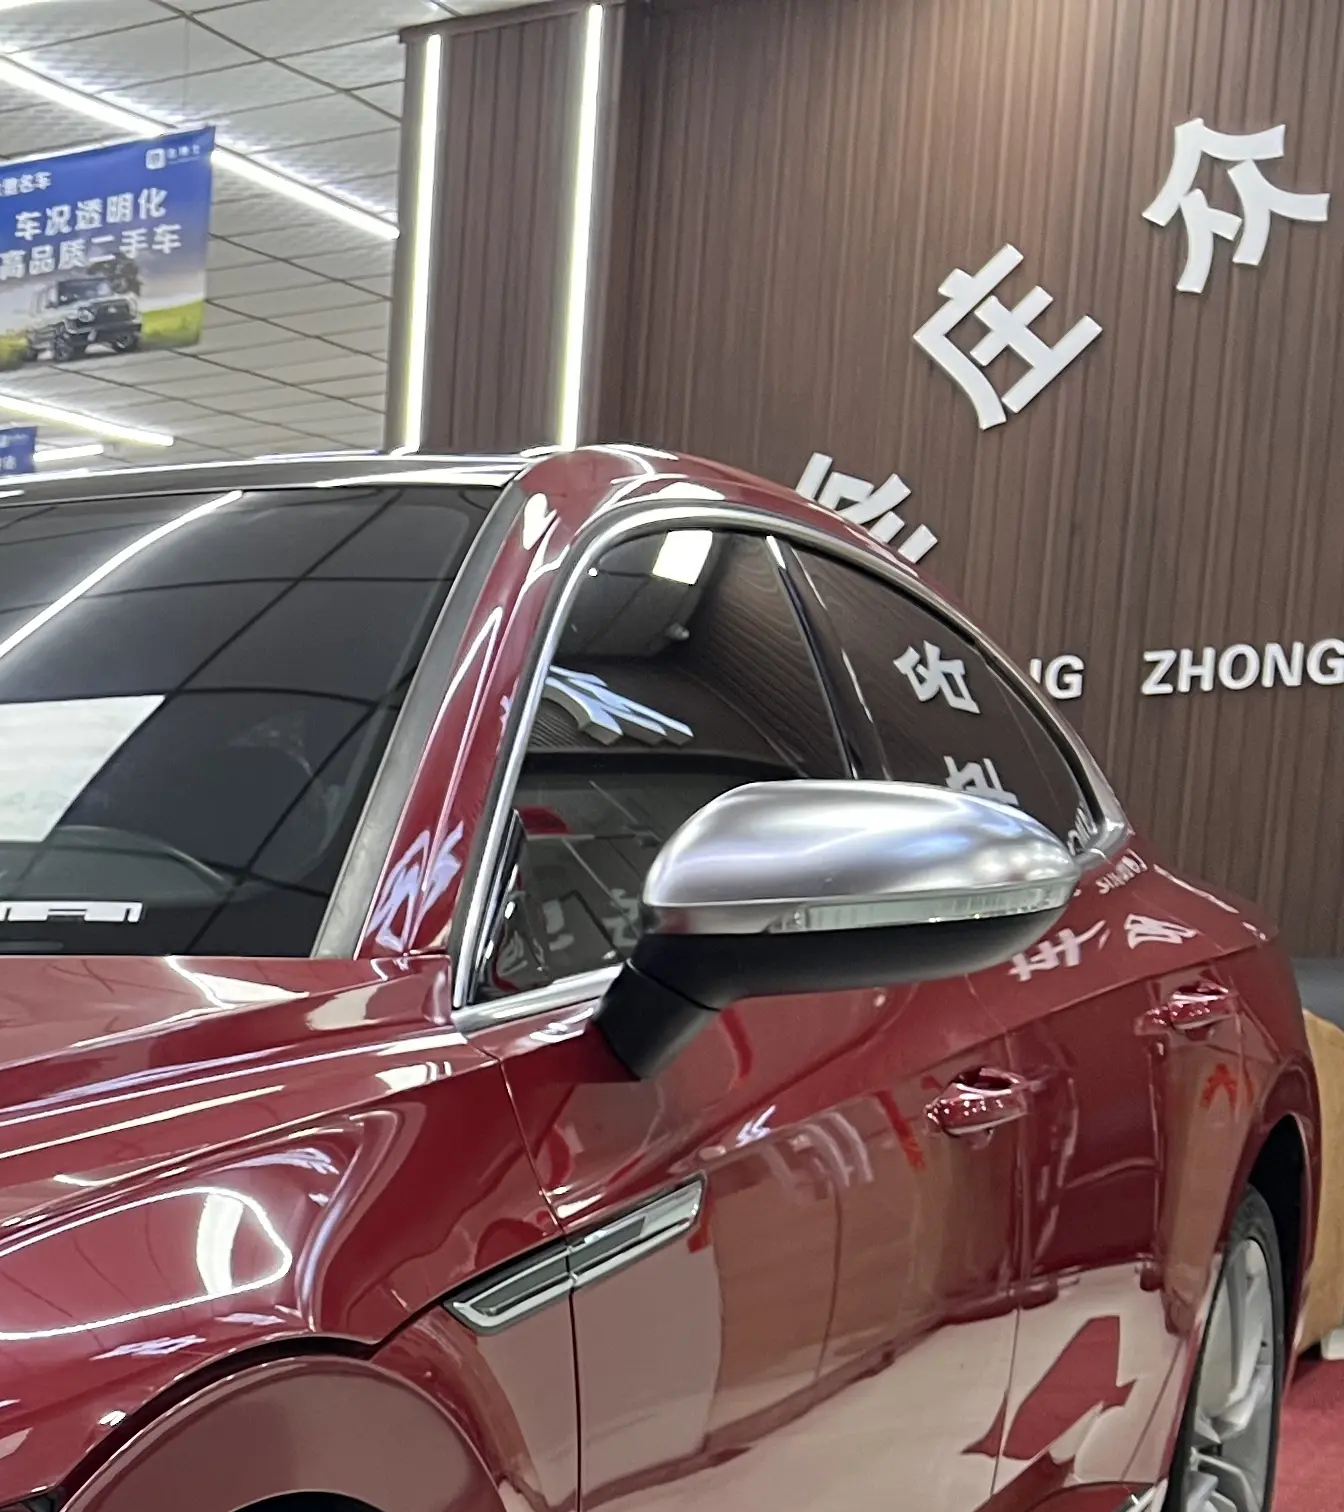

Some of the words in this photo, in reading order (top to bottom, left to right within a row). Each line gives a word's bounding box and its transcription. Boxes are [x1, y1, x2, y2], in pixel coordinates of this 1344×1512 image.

[14, 188, 168, 240] 车况透明化
[0, 224, 182, 281] 高品质二手车
[1141, 638, 1344, 696] ZHONG
